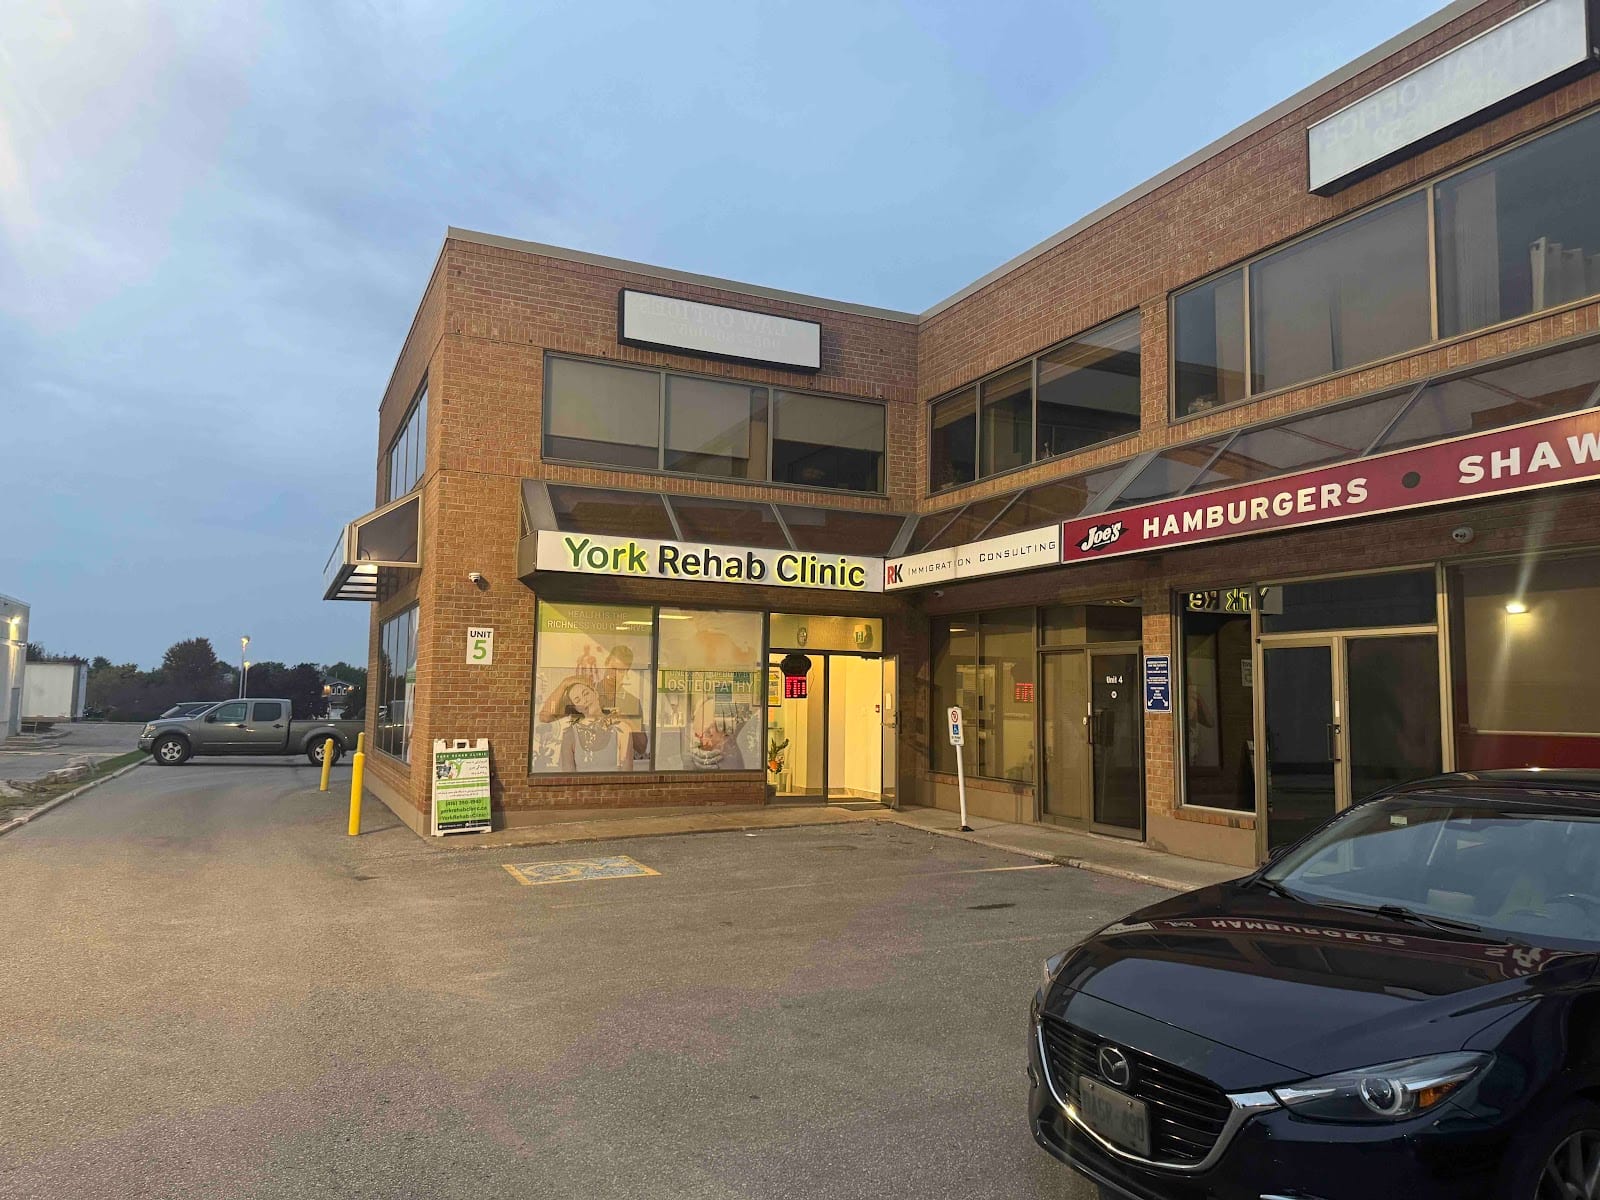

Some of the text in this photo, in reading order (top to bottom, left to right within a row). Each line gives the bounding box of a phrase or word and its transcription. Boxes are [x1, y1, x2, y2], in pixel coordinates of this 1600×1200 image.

[1143, 477, 1369, 540] HAMBURGERS
[564, 537, 866, 588] York Rehab Clinic
[887, 563, 903, 585] RK
[469, 630, 493, 639] UNIT
[547, 620, 590, 630] RICHNESS
[473, 639, 487, 660] 5
[668, 679, 754, 693] OSTEOPATHY
